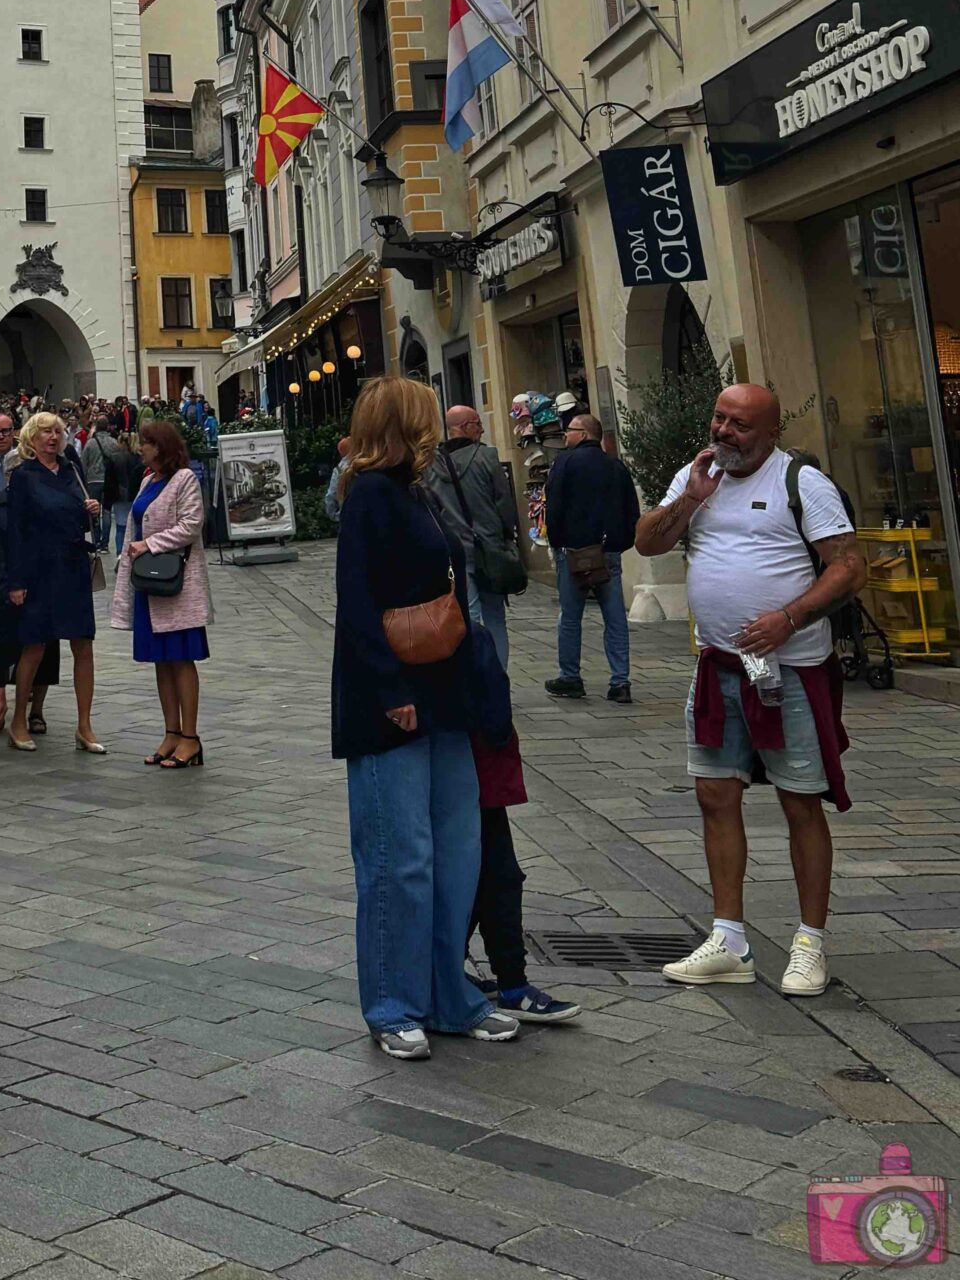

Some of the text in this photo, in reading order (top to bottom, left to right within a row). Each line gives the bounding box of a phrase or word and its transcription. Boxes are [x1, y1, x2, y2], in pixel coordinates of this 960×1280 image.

[841, 31, 880, 61] OBCHOD
[774, 25, 930, 138] HONEYSHOP
[640, 148, 692, 279] CIGÁR
[476, 217, 553, 283] SOUVENIRS
[627, 228, 653, 282] DOM
